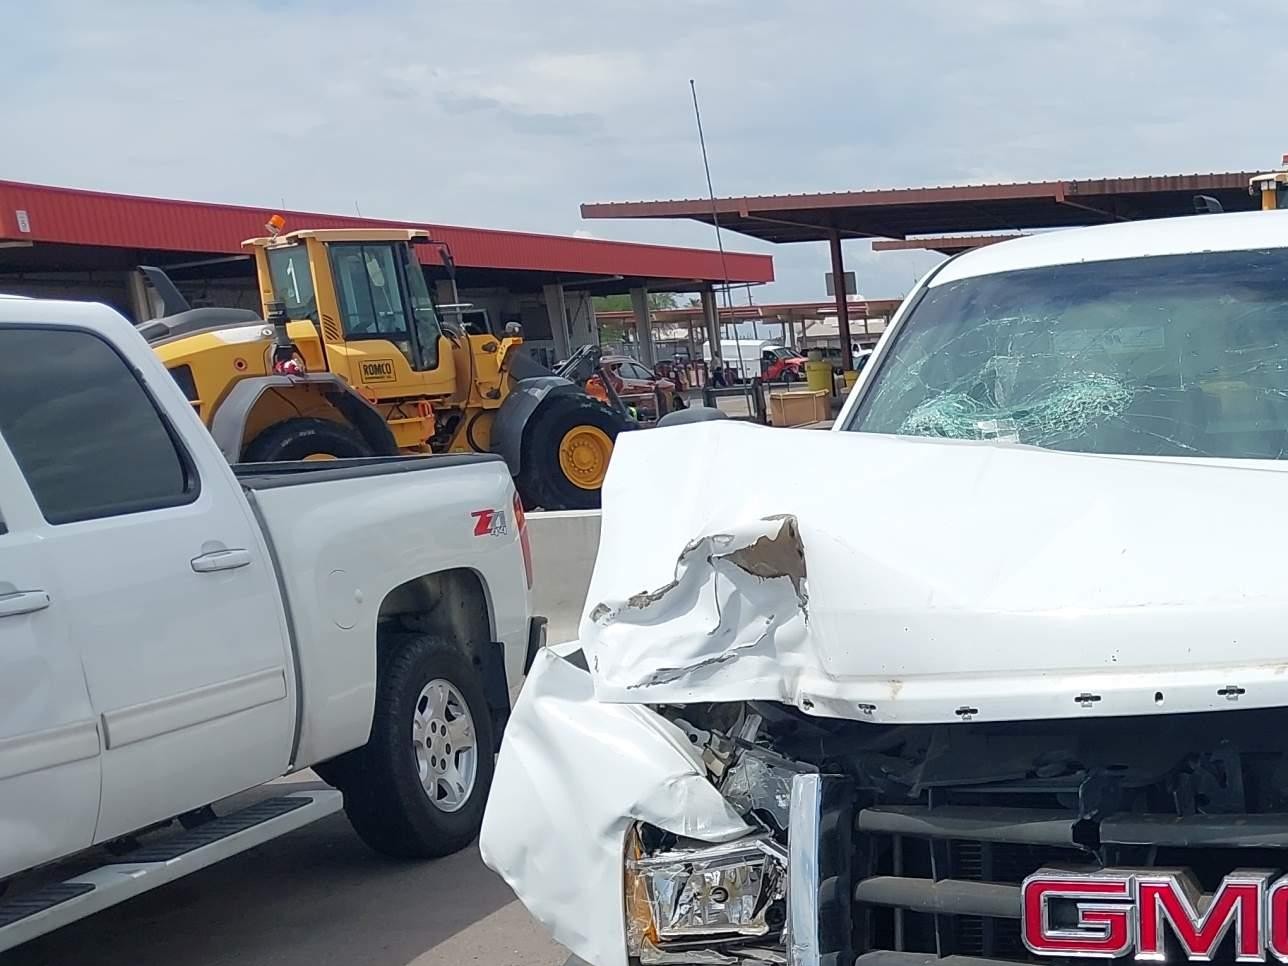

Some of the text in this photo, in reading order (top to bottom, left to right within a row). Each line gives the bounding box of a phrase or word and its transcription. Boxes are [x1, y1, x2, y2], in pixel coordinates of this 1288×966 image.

[286, 257, 301, 304] 1
[363, 362, 392, 376] ROMCO
[471, 508, 506, 537] Z71
